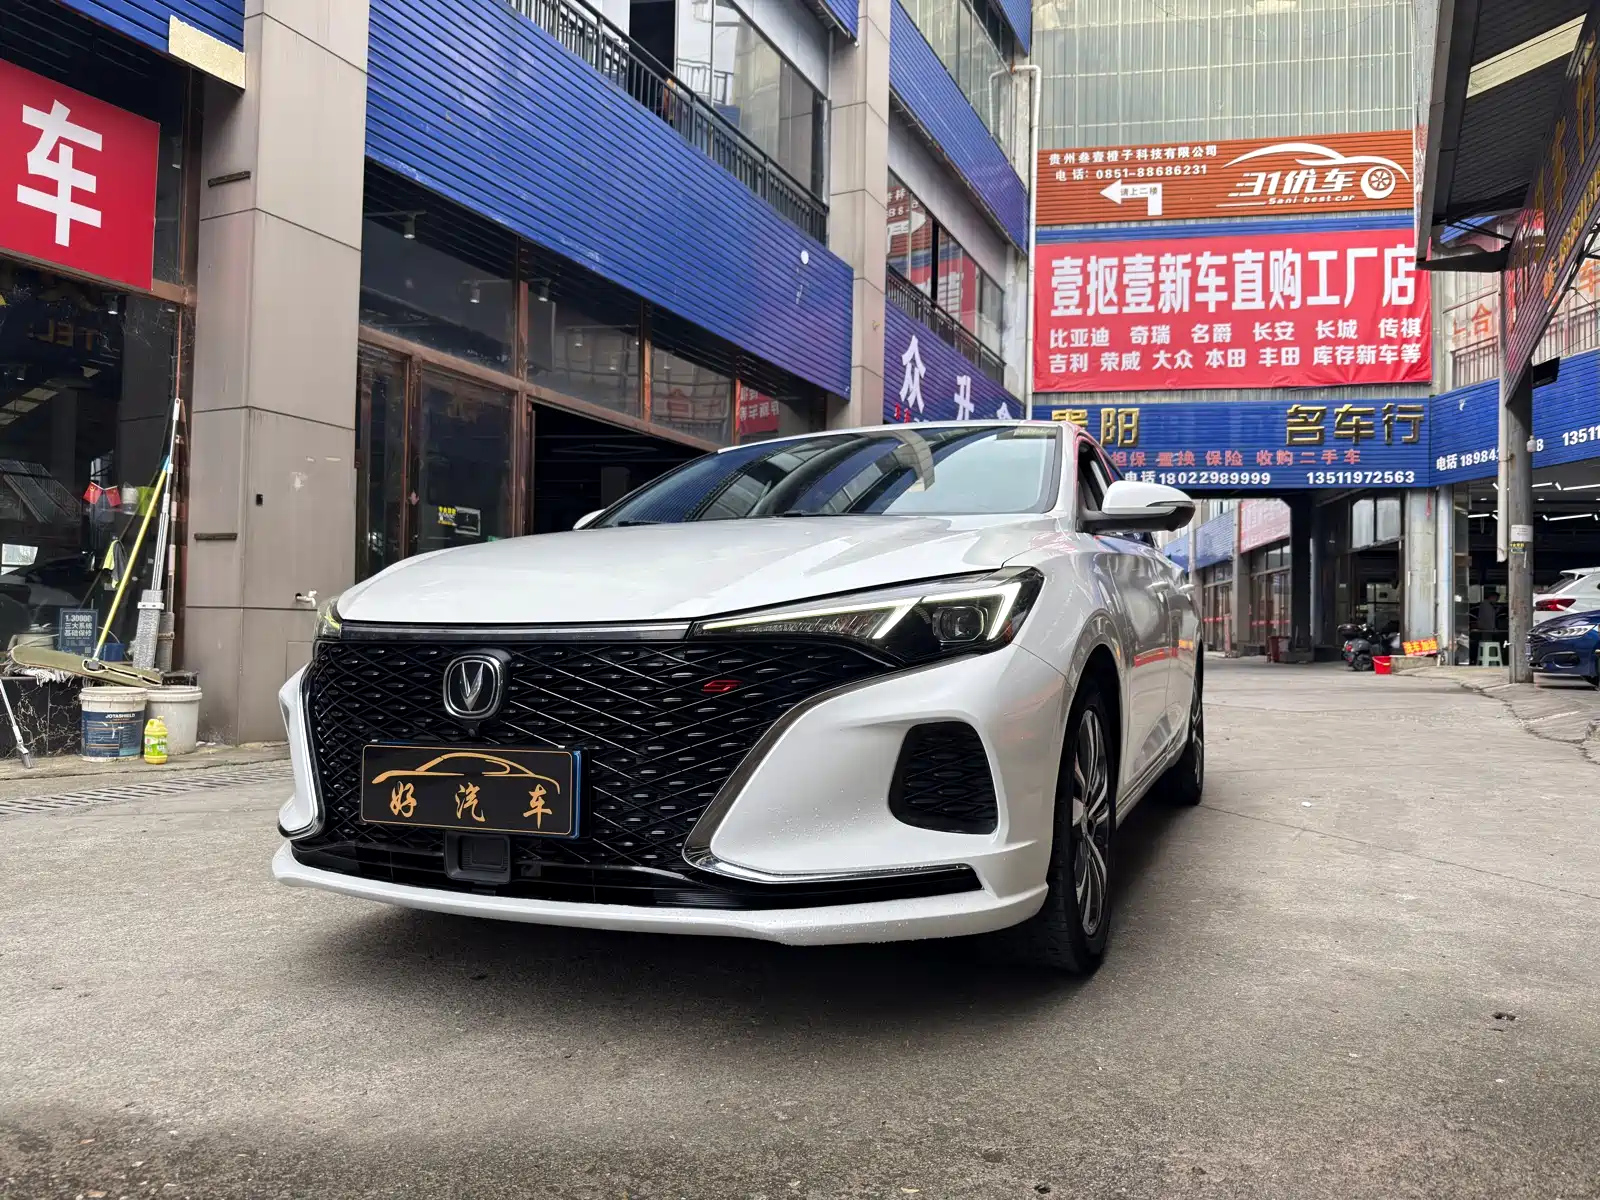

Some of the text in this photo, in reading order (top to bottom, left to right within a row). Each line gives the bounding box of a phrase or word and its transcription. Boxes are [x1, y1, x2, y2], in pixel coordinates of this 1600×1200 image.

[17, 99, 102, 247] 车
[1303, 195, 1331, 203] best
[1050, 244, 1416, 317] 壹抠壹新车直购工厂店
[1050, 317, 1421, 348] 比亚迪 奇瑞 名爵 长安 长城 传祺
[1049, 343, 1421, 373] 吉利 荣威 大众 本田 丰田 库存新车等
[1286, 403, 1424, 446] 名车行
[1205, 450, 1243, 466] 保险
[1306, 471, 1415, 485] 13511972563
[390, 781, 553, 829] 好汽车
